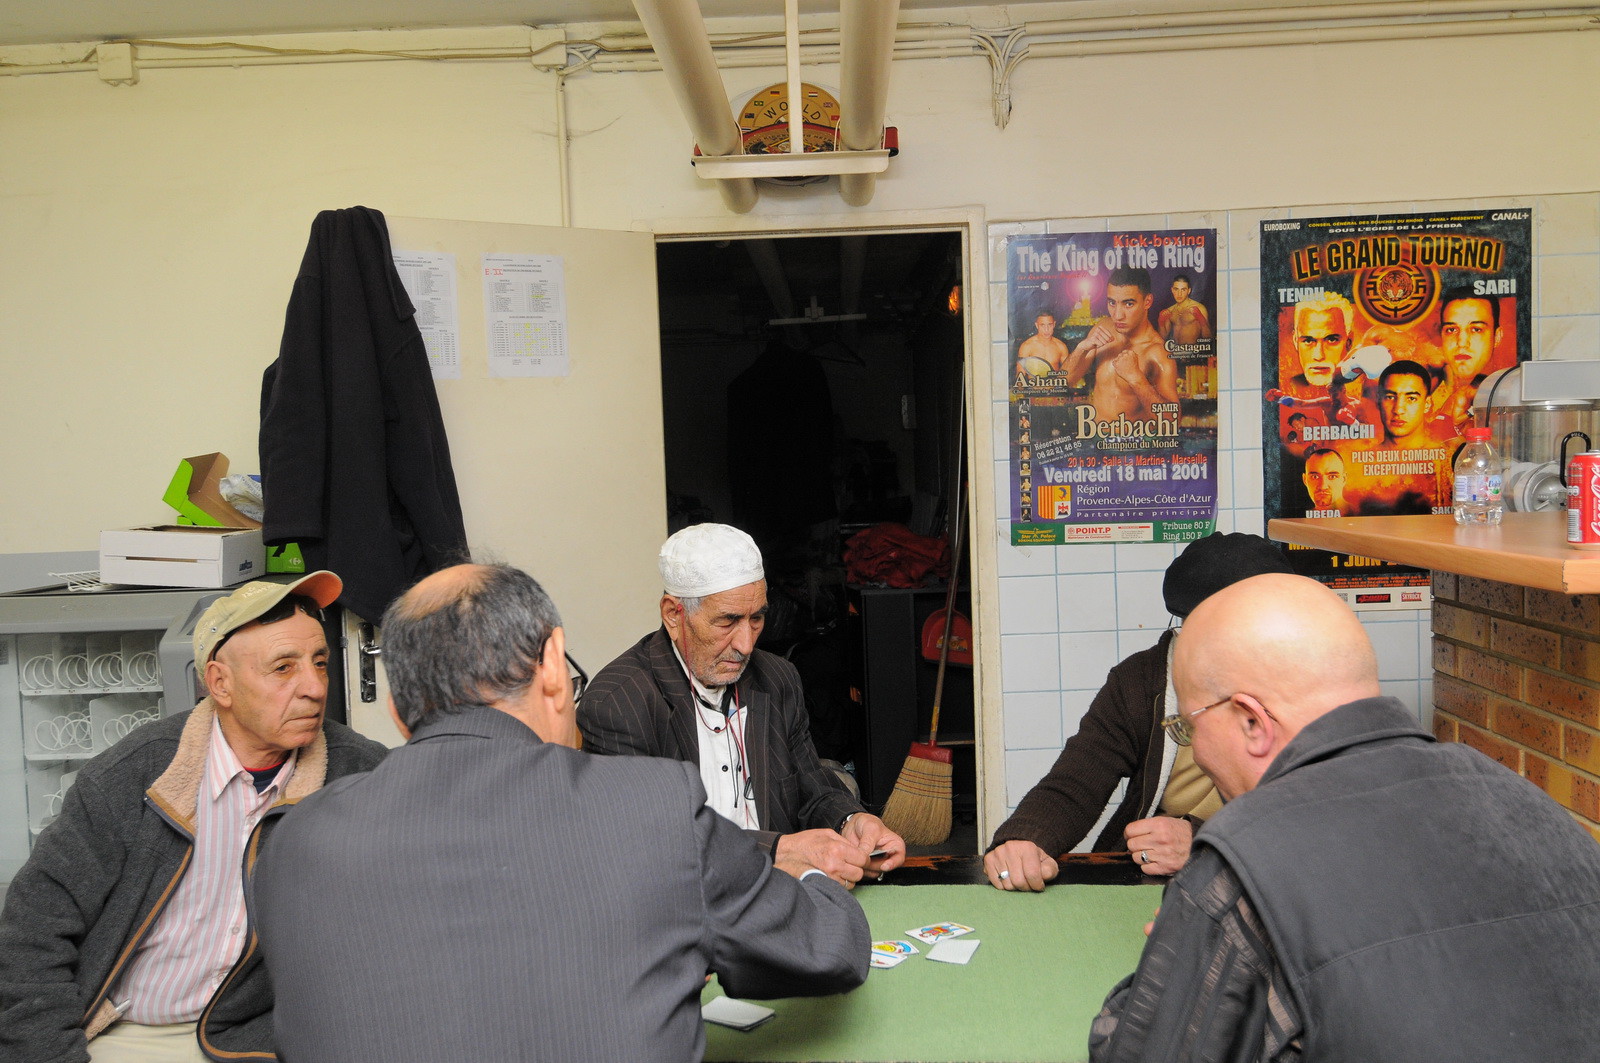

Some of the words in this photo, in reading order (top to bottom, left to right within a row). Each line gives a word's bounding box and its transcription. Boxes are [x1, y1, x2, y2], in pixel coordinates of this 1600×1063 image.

[763, 101, 821, 120] WOLD
[1491, 212, 1530, 221] CANAL+
[1264, 222, 1301, 232] EUROBOXING
[1112, 232, 1205, 249] Kick-boxing
[1016, 245, 1052, 273] The
[1057, 243, 1099, 277] King
[1104, 244, 1123, 271] of
[1127, 243, 1158, 270] the
[1164, 241, 1205, 273] Ring
[1293, 246, 1321, 280] LE
[1326, 235, 1400, 273] GRAND
[1407, 236, 1503, 272] TOURNOI
[1473, 278, 1517, 295] SARI
[1164, 339, 1211, 353] Castagna
[1013, 372, 1068, 388] Asham
[1151, 403, 1179, 413] SAMIR
[1075, 405, 1180, 440] Berbachi
[1303, 424, 1375, 441] BERBACHI
[1034, 435, 1072, 450] Réservation
[1096, 440, 1138, 452] Champion
[1139, 439, 1150, 449] du
[1151, 439, 1179, 449] Monde
[1046, 448, 1055, 457] 22
[1352, 450, 1375, 463] PLUS
[1376, 449, 1400, 463] DEUX
[1401, 448, 1447, 461] COMBATS
[1068, 456, 1077, 468] 20
[1080, 456, 1085, 467] h
[1087, 456, 1096, 467] 30
[1102, 455, 1123, 467] Salle
[1124, 455, 1134, 466] La
[1135, 454, 1166, 466] Martine
[1171, 453, 1208, 465] Marseille
[1043, 465, 1111, 484] Vendredi
[1116, 464, 1135, 482] 18
[1138, 463, 1167, 481] mai
[1171, 462, 1208, 480] 2001
[1363, 462, 1435, 476] EXCEPTIONNELS
[1077, 485, 1110, 496] Région
[1077, 494, 1177, 506] Provence-Alpes-Côte
[1179, 494, 1212, 503] d'Azur
[1152, 508, 1212, 517] principal
[1305, 509, 1342, 519] UBEDA
[1076, 526, 1111, 534] POINT.P
[1162, 521, 1193, 530] Tribune
[1194, 521, 1204, 529] 80
[1205, 521, 1211, 529] F
[1162, 532, 1181, 541] Ring
[1182, 531, 1196, 540] 150
[1197, 531, 1203, 540] F
[1331, 555, 1338, 568] 1
[1344, 555, 1381, 568] JUIN
